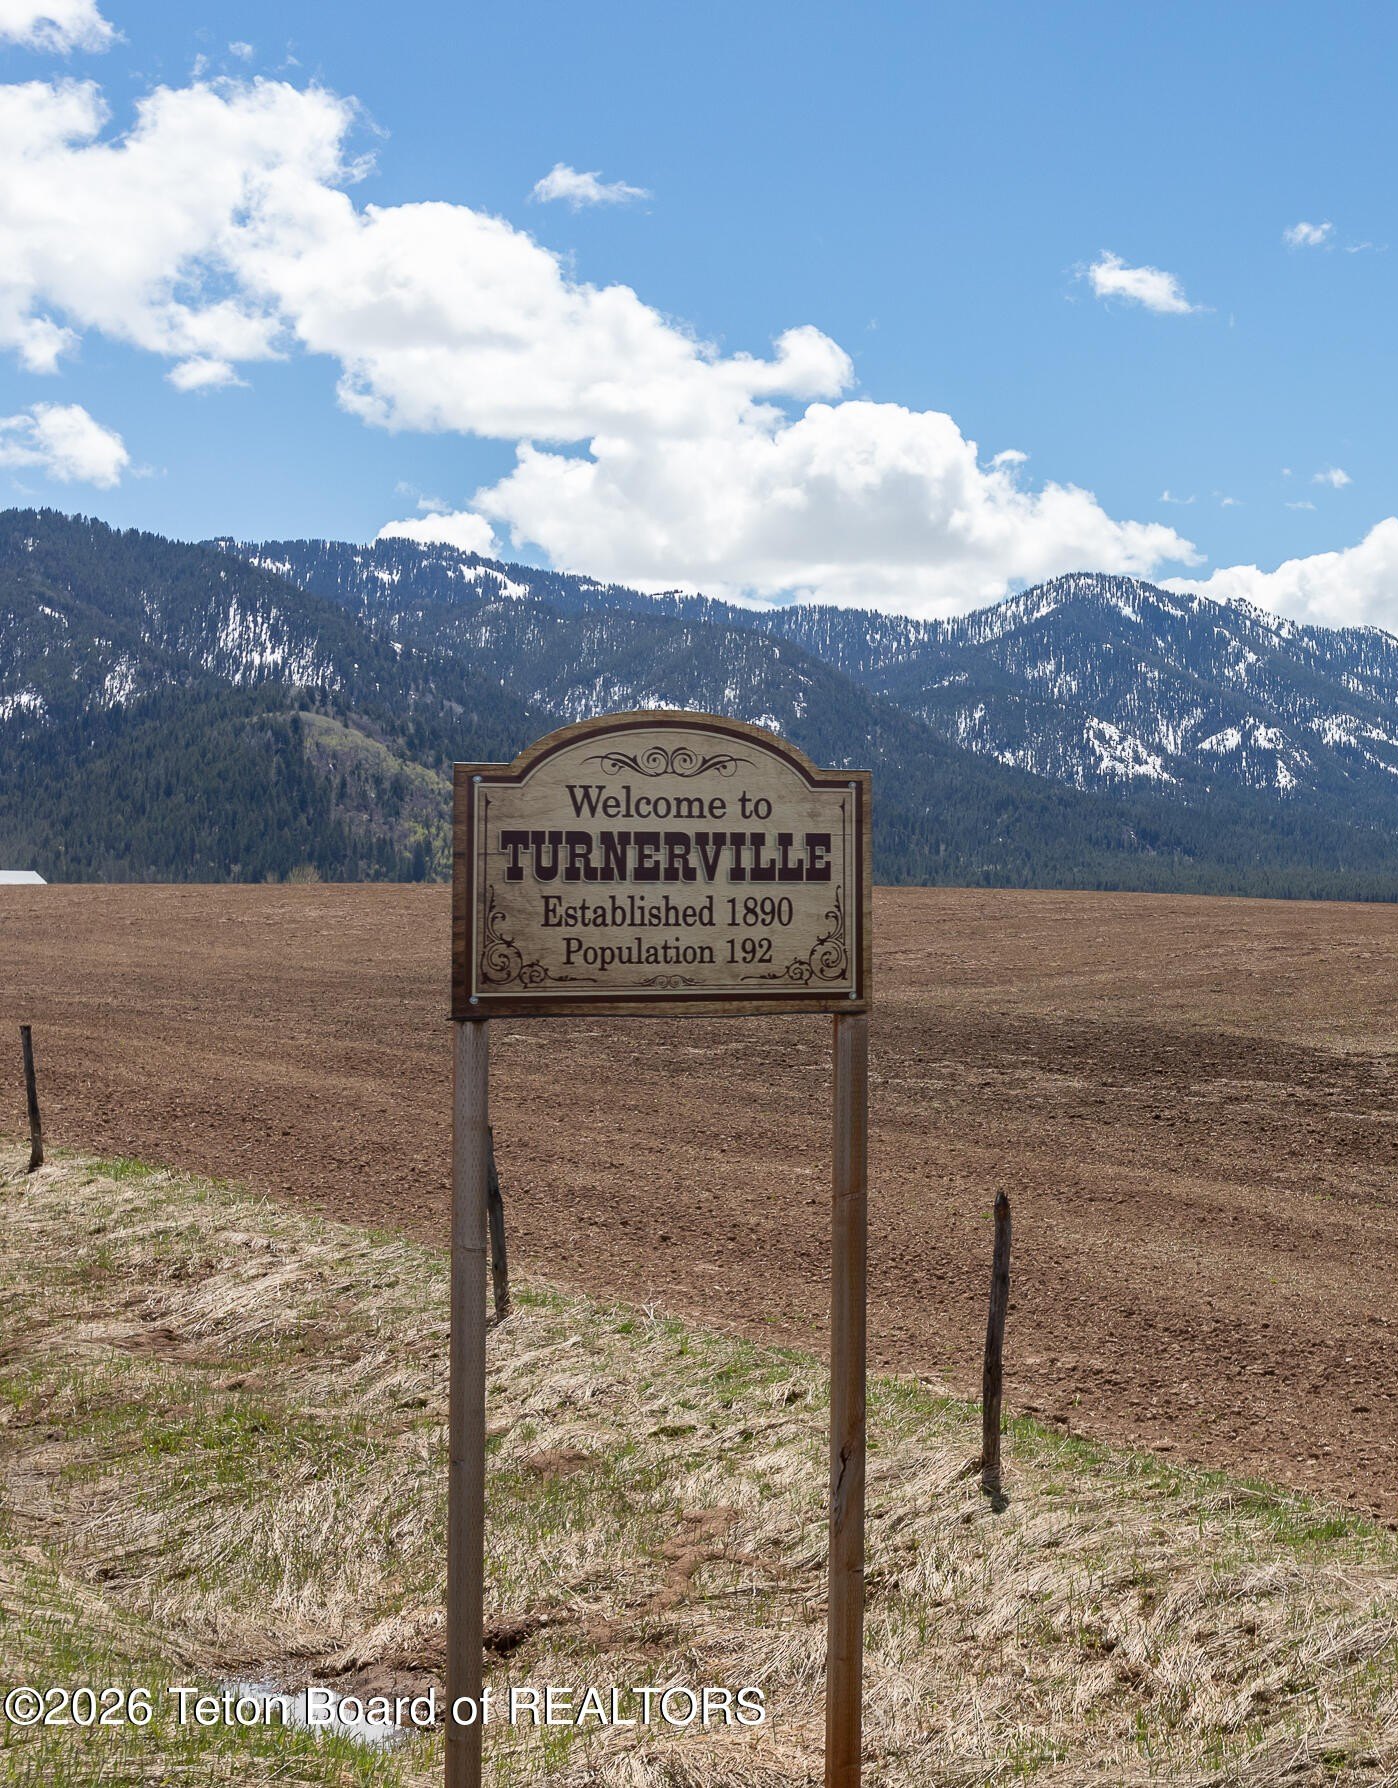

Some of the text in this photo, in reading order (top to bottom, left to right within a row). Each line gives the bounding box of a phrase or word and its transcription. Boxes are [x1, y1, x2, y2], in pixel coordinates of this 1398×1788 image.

[566, 785, 773, 820] Welcome to
[500, 830, 832, 882] TURNERVILLE
[541, 895, 794, 928] Established 1890
[563, 937, 773, 971] Population 192
